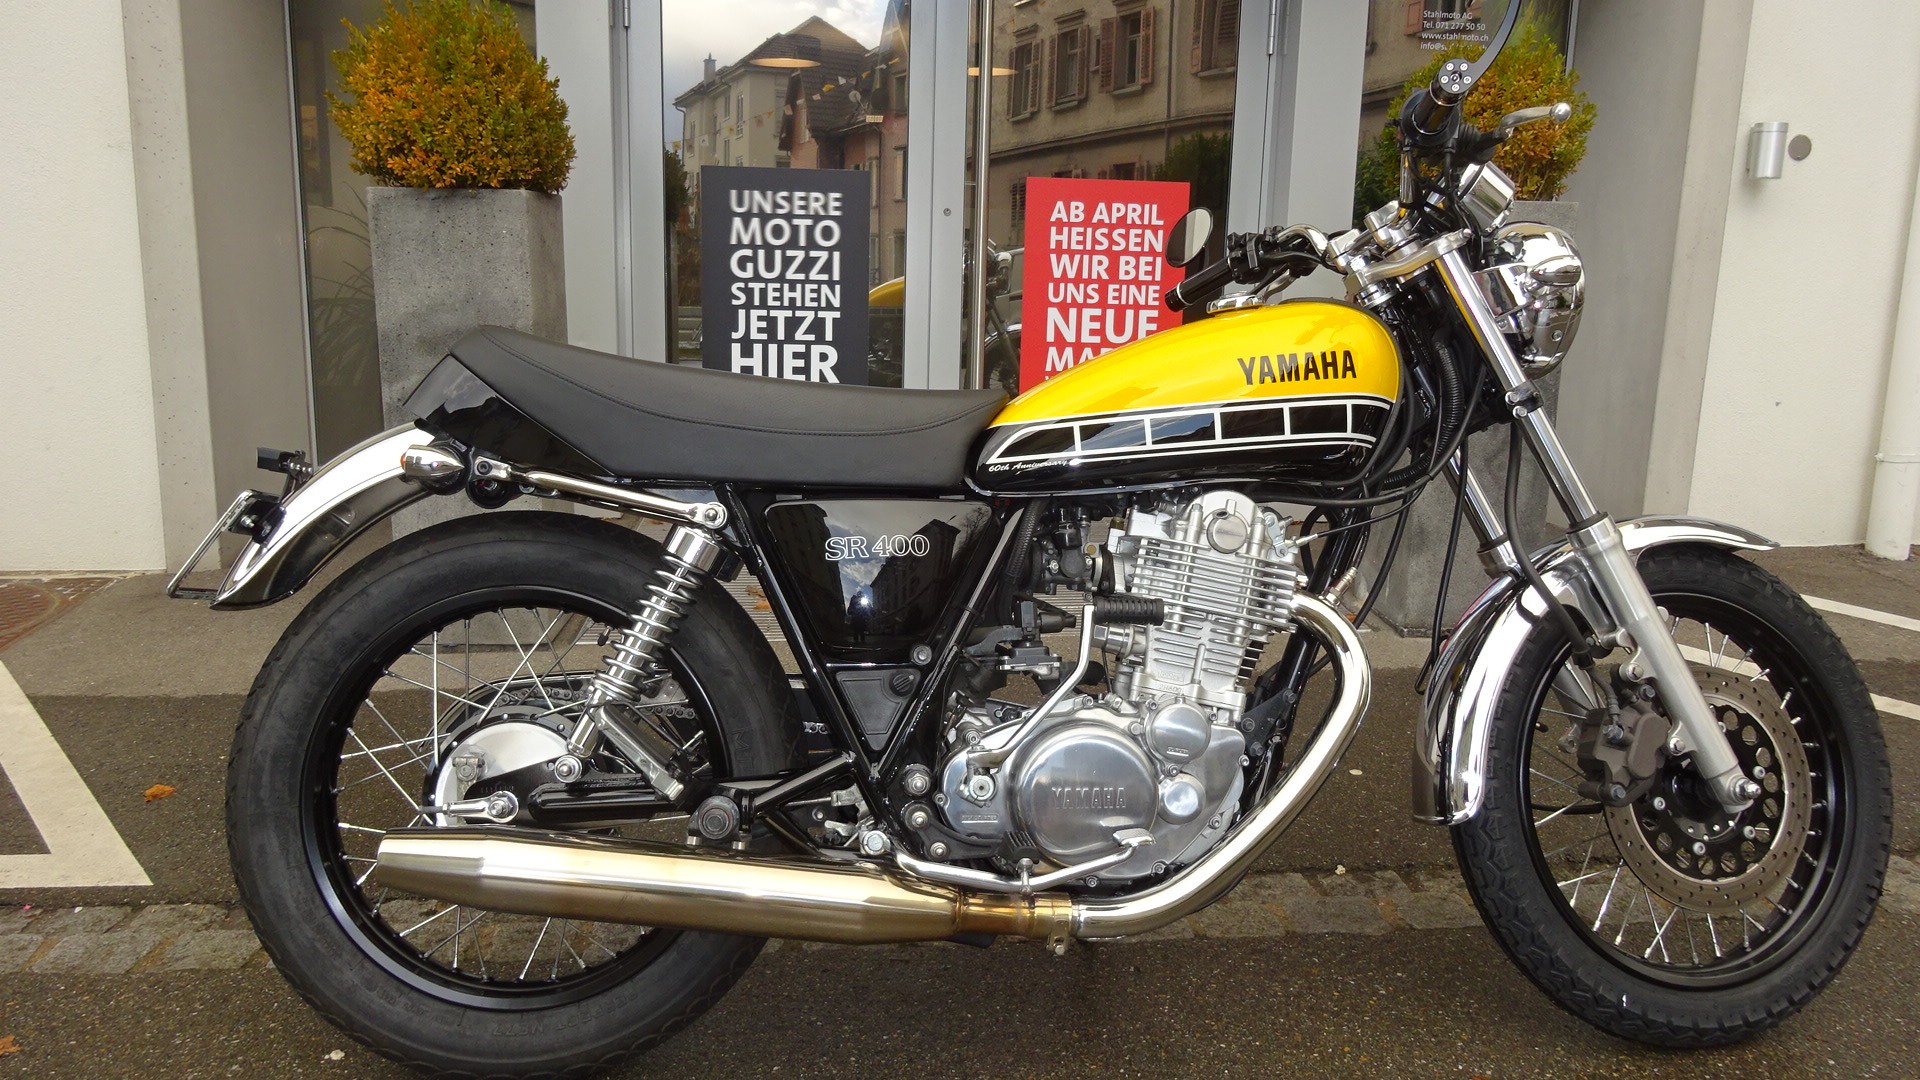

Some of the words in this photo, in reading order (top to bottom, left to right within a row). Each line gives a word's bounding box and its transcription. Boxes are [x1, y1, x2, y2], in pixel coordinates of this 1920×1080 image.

[1423, 10, 1461, 19] Stahlmoto
[1461, 12, 1473, 20] AG
[1423, 21, 1435, 29] Tel.
[1435, 21, 1449, 30] 071
[1450, 22, 1465, 30] 277
[1466, 22, 1475, 31] 50
[1476, 23, 1486, 31] 50
[729, 189, 843, 216] UNSERE
[1050, 200, 1085, 223] AB
[1091, 202, 1164, 226] APRIL
[729, 217, 841, 247] MOTO
[1049, 226, 1163, 253] HEISSEN
[729, 249, 841, 281] GUZZI
[1050, 253, 1109, 280] WIR
[1118, 255, 1162, 281] BEI
[730, 282, 841, 308] STEHEN
[1048, 282, 1099, 304] UNS
[1107, 284, 1160, 306] EINE
[731, 309, 841, 341] JETZT
[731, 342, 840, 384] HIER
[1237, 350, 1357, 385] YAMAHA
[988, 463, 1010, 472] 60th
[1011, 460, 1067, 471] Anniversary
[825, 535, 869, 560] SR
[872, 534, 930, 557] 400
[1051, 787, 1126, 809] YAMAHA
